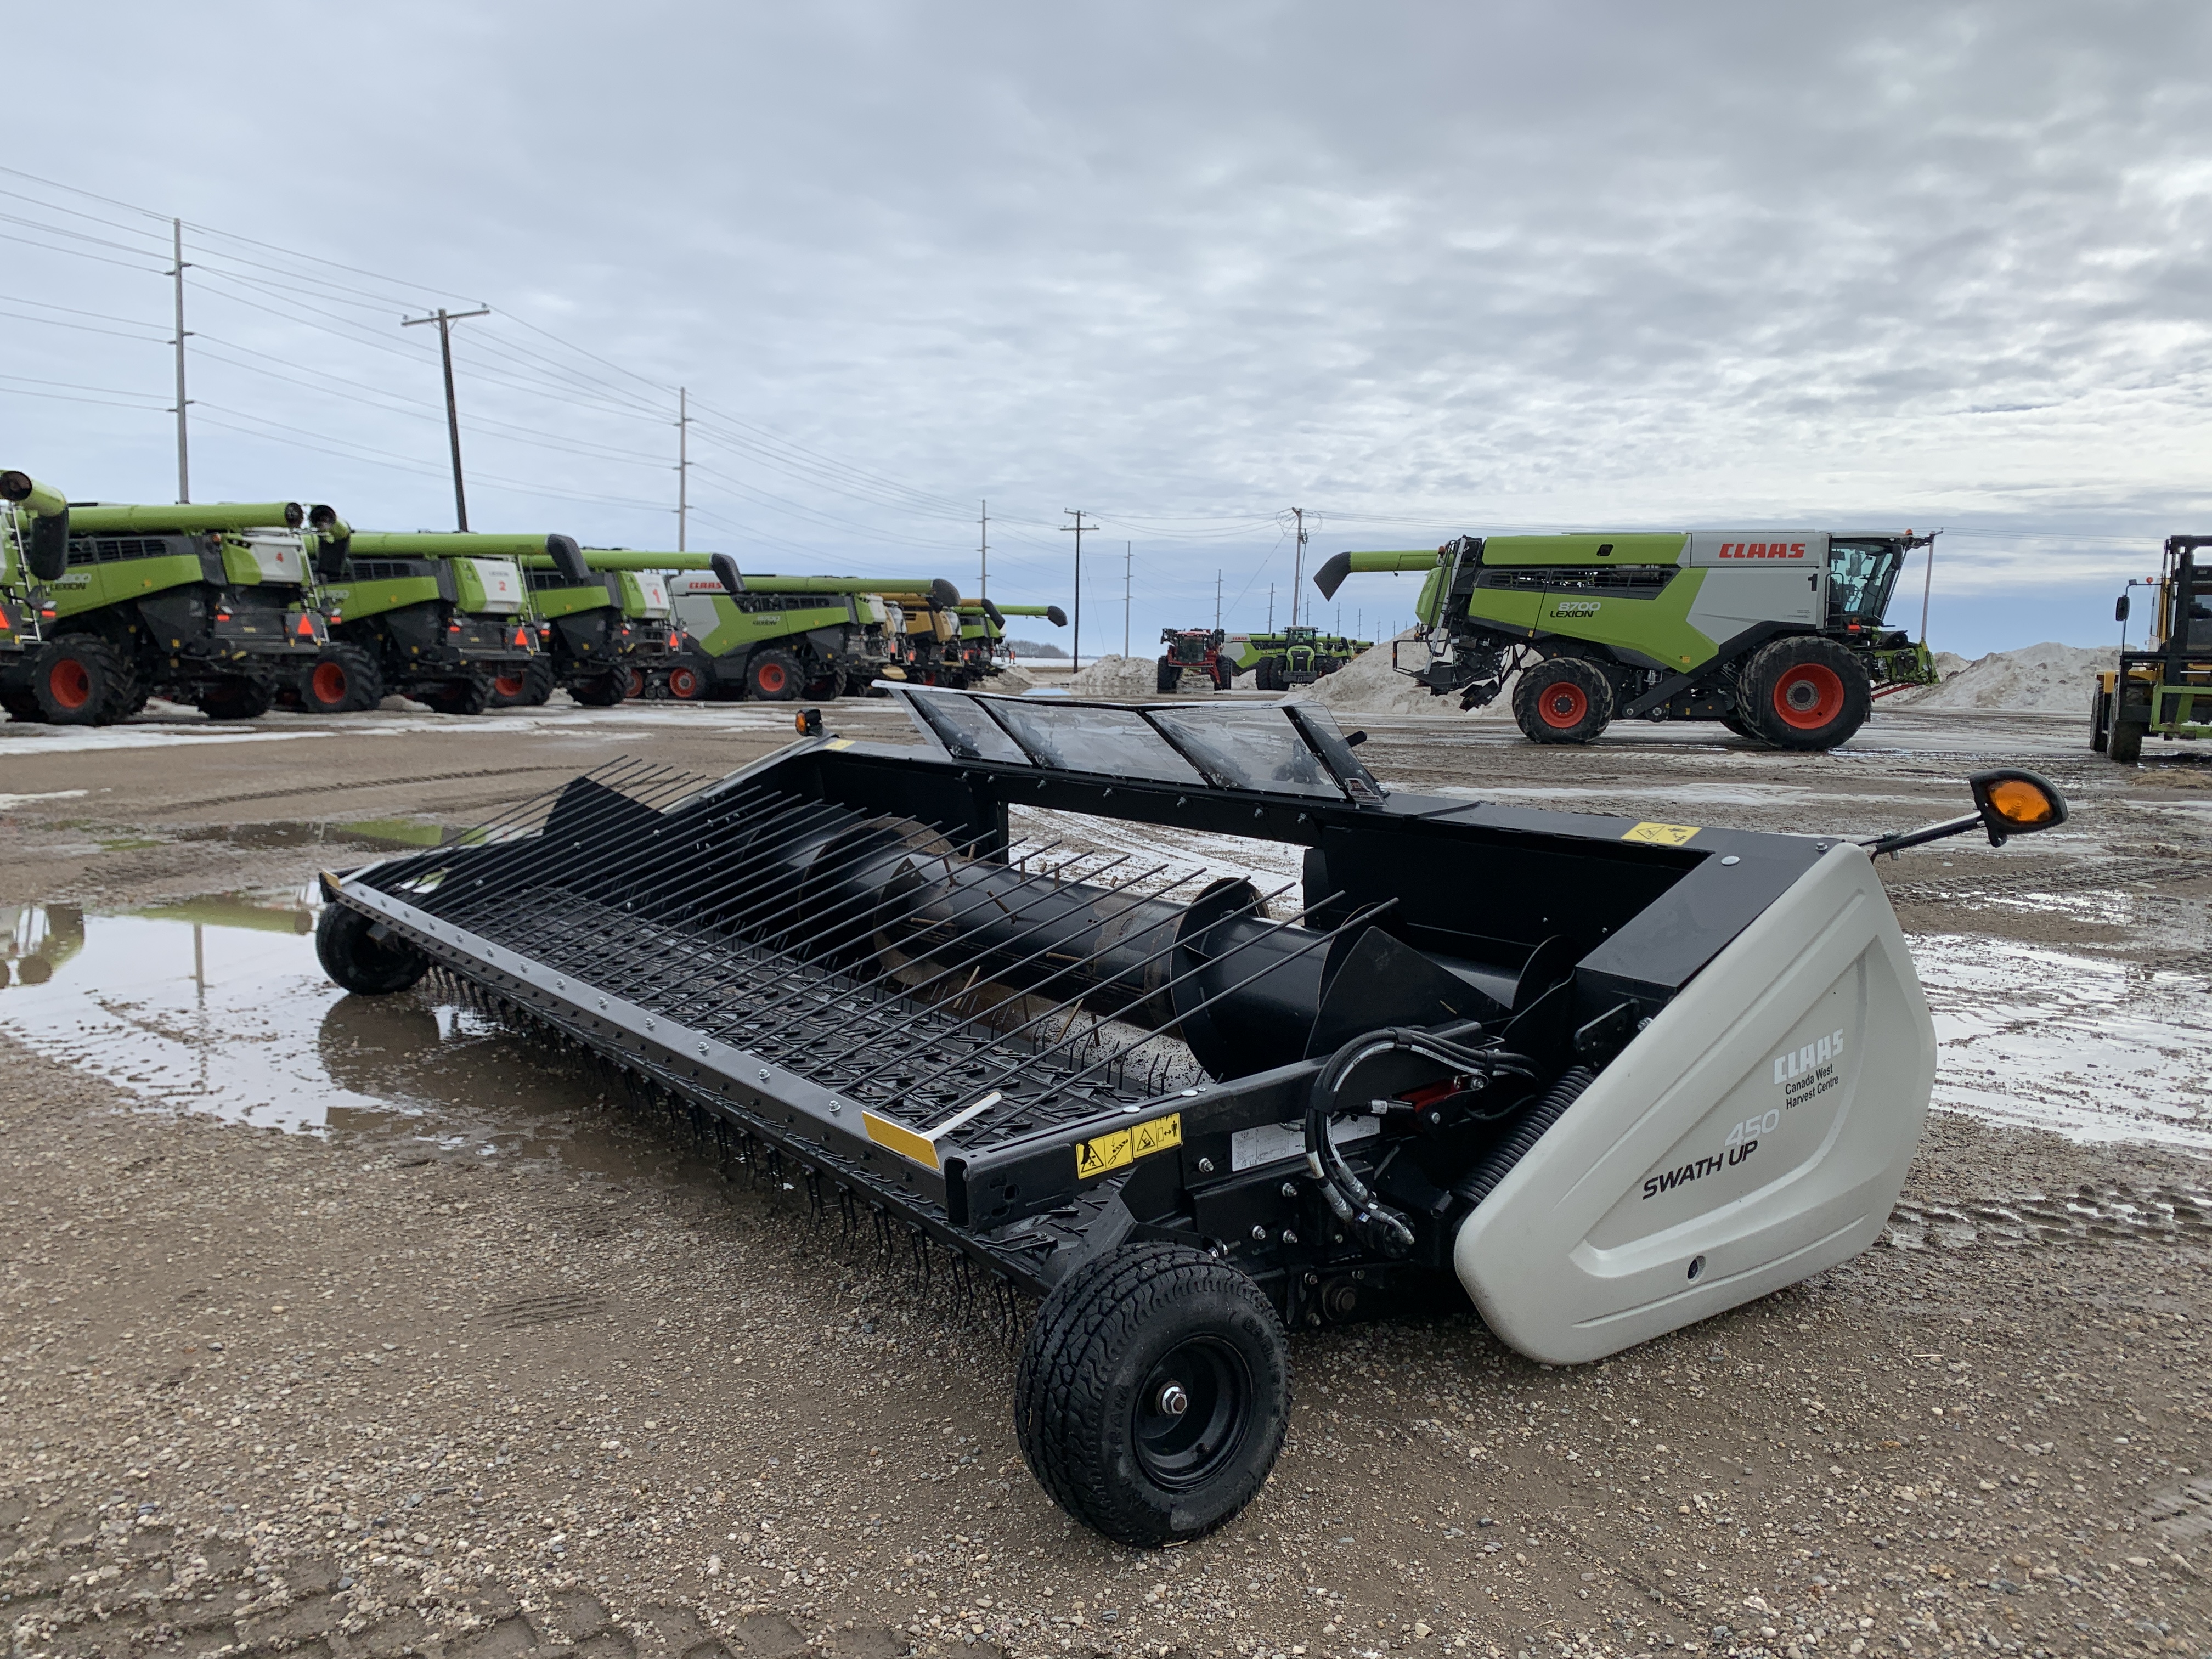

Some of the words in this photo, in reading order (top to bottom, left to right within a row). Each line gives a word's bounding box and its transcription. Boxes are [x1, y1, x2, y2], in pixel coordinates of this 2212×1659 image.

[276, 552, 284, 562] 4
[1719, 543, 1805, 558] CLAAS
[499, 580, 507, 591] 2
[1808, 573, 1818, 591] 1
[652, 588, 661, 605] 1
[1558, 602, 1601, 611] 8700
[1774, 1028, 1844, 1085] CLAAS
[1785, 1074, 1815, 1096] Canada
[1816, 1063, 1833, 1081] West
[1786, 1086, 1815, 1110] Harvest
[1817, 1076, 1839, 1094] Centre
[1724, 1108, 1780, 1147] 450
[1643, 1153, 1724, 1200] SWATH
[1729, 1139, 1758, 1166] UP
